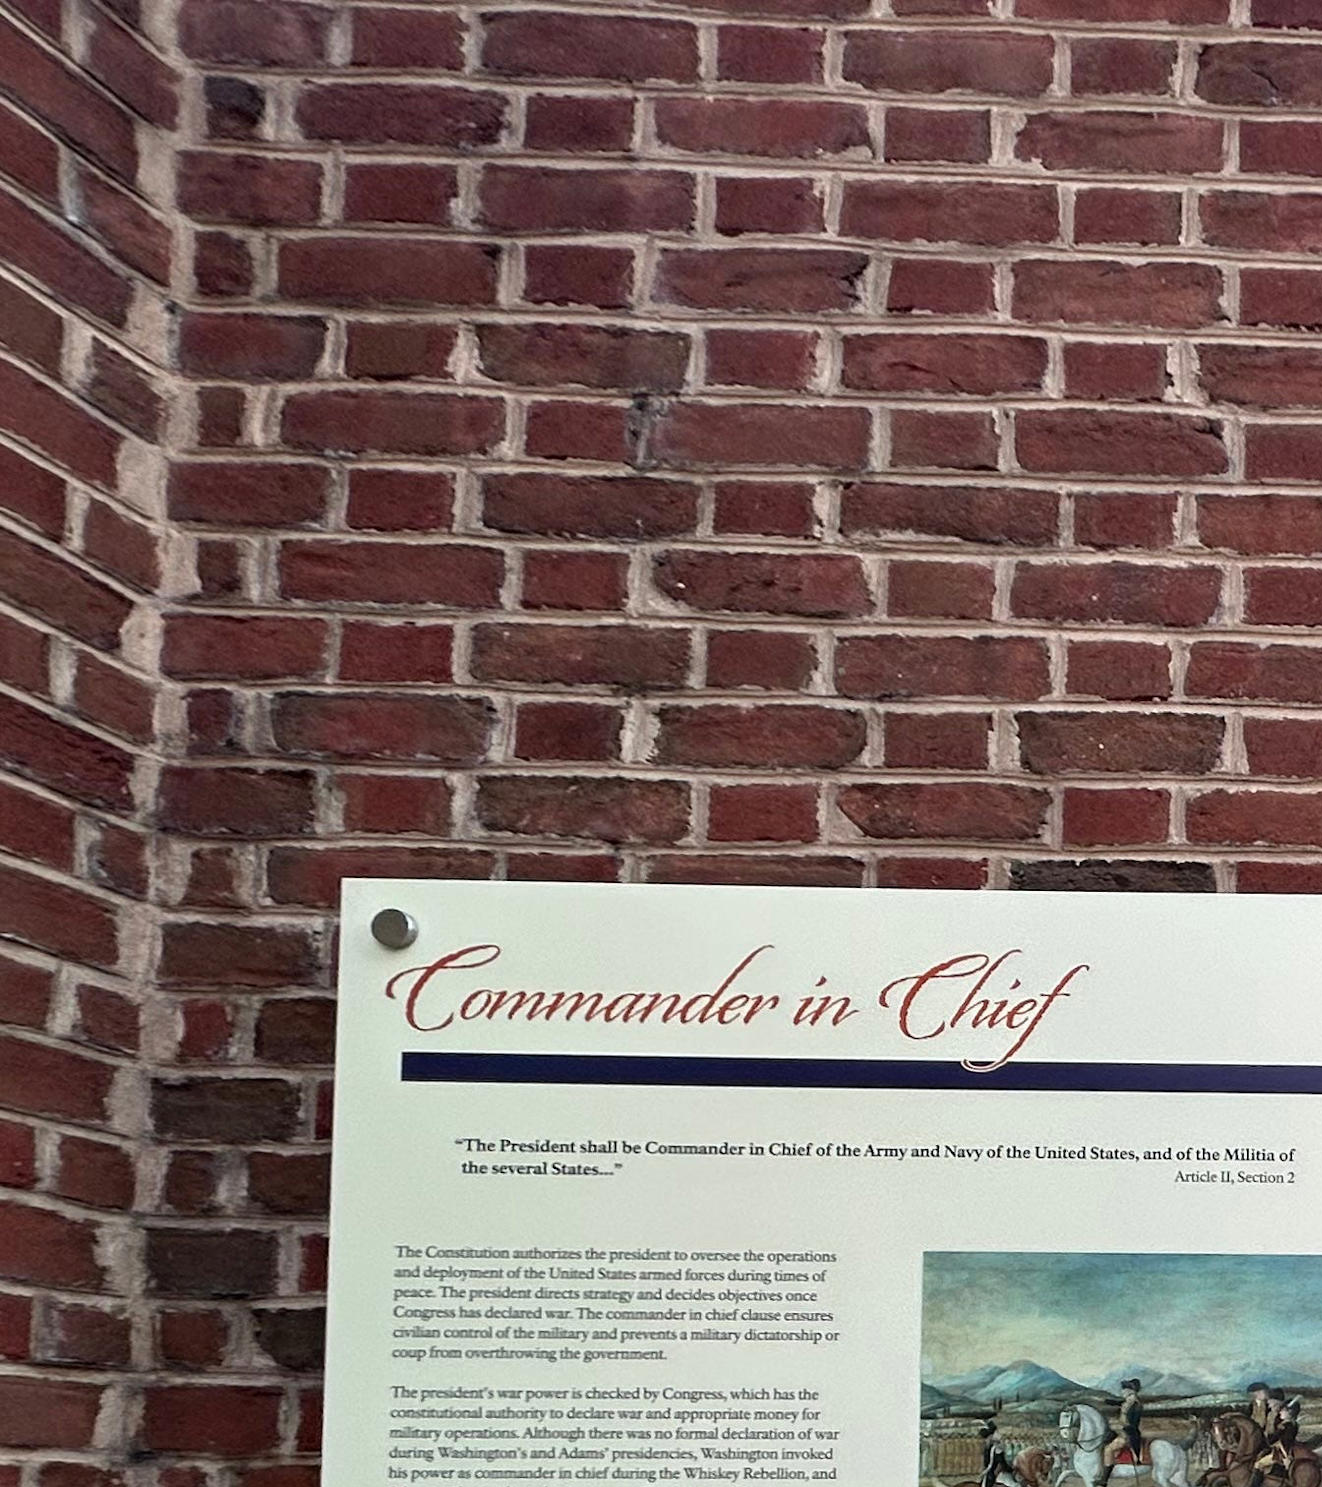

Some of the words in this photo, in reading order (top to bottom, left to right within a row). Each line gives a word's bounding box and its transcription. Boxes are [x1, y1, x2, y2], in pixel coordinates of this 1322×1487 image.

[385, 944, 780, 1032] Commander
[791, 977, 859, 1027] in
[879, 949, 1090, 1073] Chief
[500, 1139, 576, 1153] President
[579, 1140, 618, 1154] shall
[622, 1140, 642, 1154] be
[645, 1141, 746, 1156] Commander
[749, 1142, 765, 1156] in
[768, 1142, 814, 1156] Chief
[816, 1143, 834, 1157] of
[836, 1143, 861, 1157] the
[863, 1144, 908, 1161] Army
[911, 1144, 940, 1158] and
[944, 1145, 984, 1162] Navy
[986, 1145, 1004, 1159] of
[1006, 1145, 1031, 1159] the
[1035, 1146, 1087, 1160] United
[1090, 1146, 1140, 1162] States,
[1143, 1147, 1172, 1160] and
[1176, 1147, 1194, 1161] of
[1196, 1147, 1220, 1161] the
[1224, 1148, 1275, 1162] Militia
[1279, 1148, 1296, 1162] of
[461, 1160, 489, 1174] the
[491, 1161, 548, 1175] several
[1174, 1170, 1218, 1183] Article
[1220, 1170, 1235, 1185] II,
[1237, 1170, 1284, 1184] Section
[1287, 1171, 1295, 1184] 2
[391, 1349, 427, 1362] coup
[429, 1345, 463, 1359] from
[464, 1346, 558, 1363] overthrowing
[559, 1346, 581, 1360] the
[582, 1350, 668, 1364] government.
